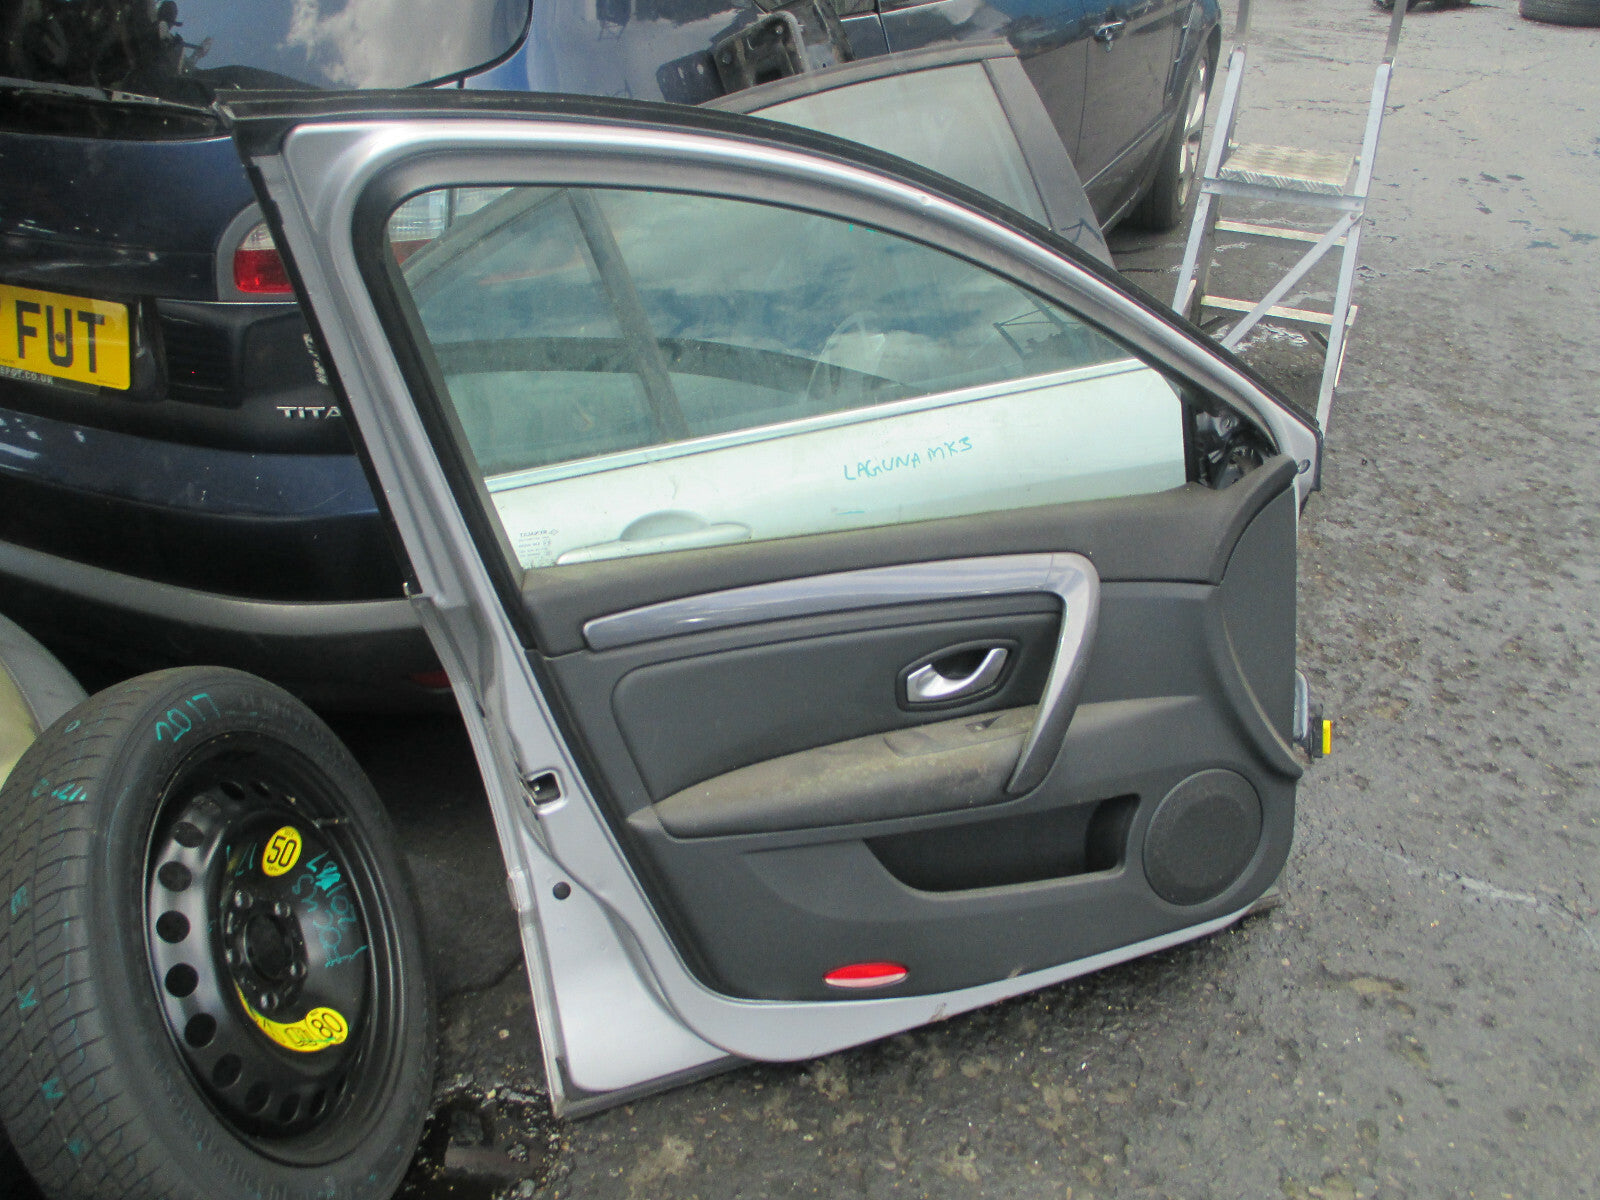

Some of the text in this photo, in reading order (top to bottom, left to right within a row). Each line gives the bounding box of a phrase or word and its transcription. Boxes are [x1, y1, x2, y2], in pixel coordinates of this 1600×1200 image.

[16, 300, 105, 374] FUT
[844, 453, 921, 480] LAGUNA
[267, 835, 297, 867] 50
[311, 1012, 343, 1039] 80
